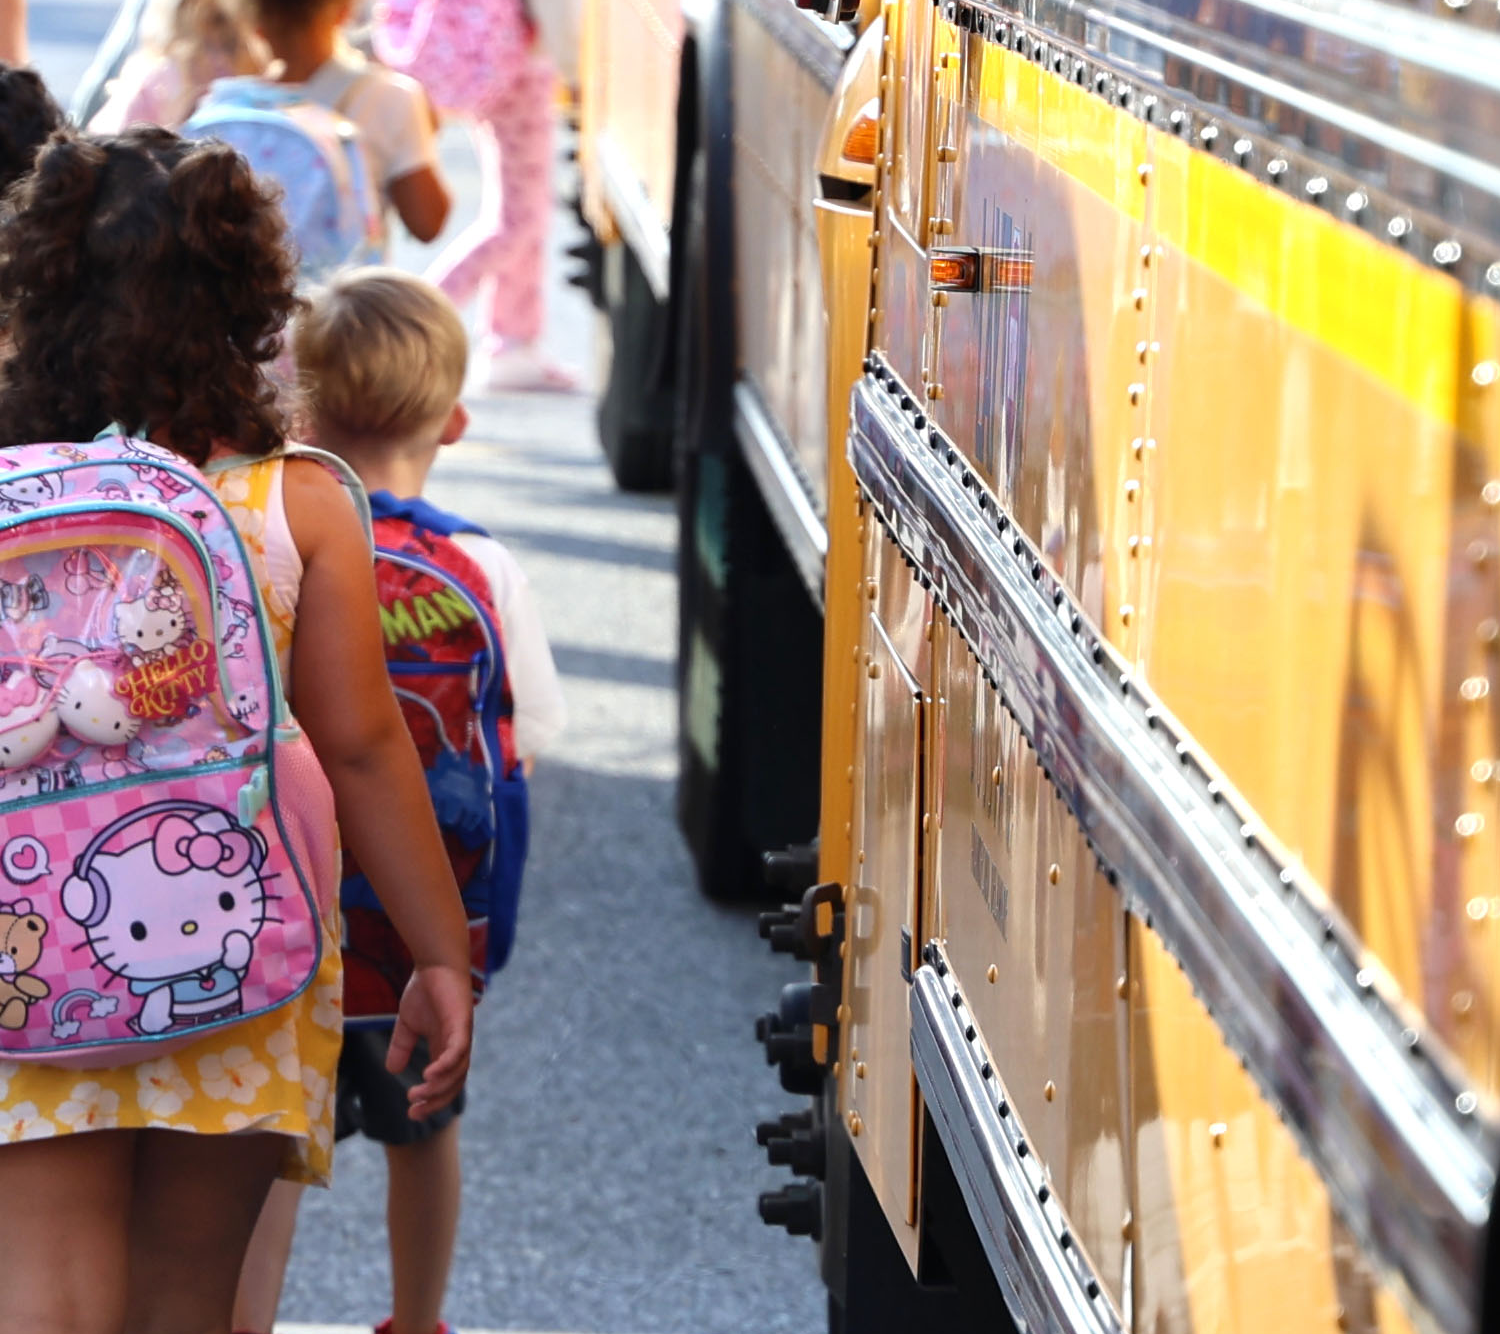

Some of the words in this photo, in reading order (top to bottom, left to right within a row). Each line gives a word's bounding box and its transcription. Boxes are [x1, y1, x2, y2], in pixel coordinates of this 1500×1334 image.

[379, 587, 475, 644] MAN
[115, 638, 208, 699] HELLO
[130, 664, 207, 717] KITTY
